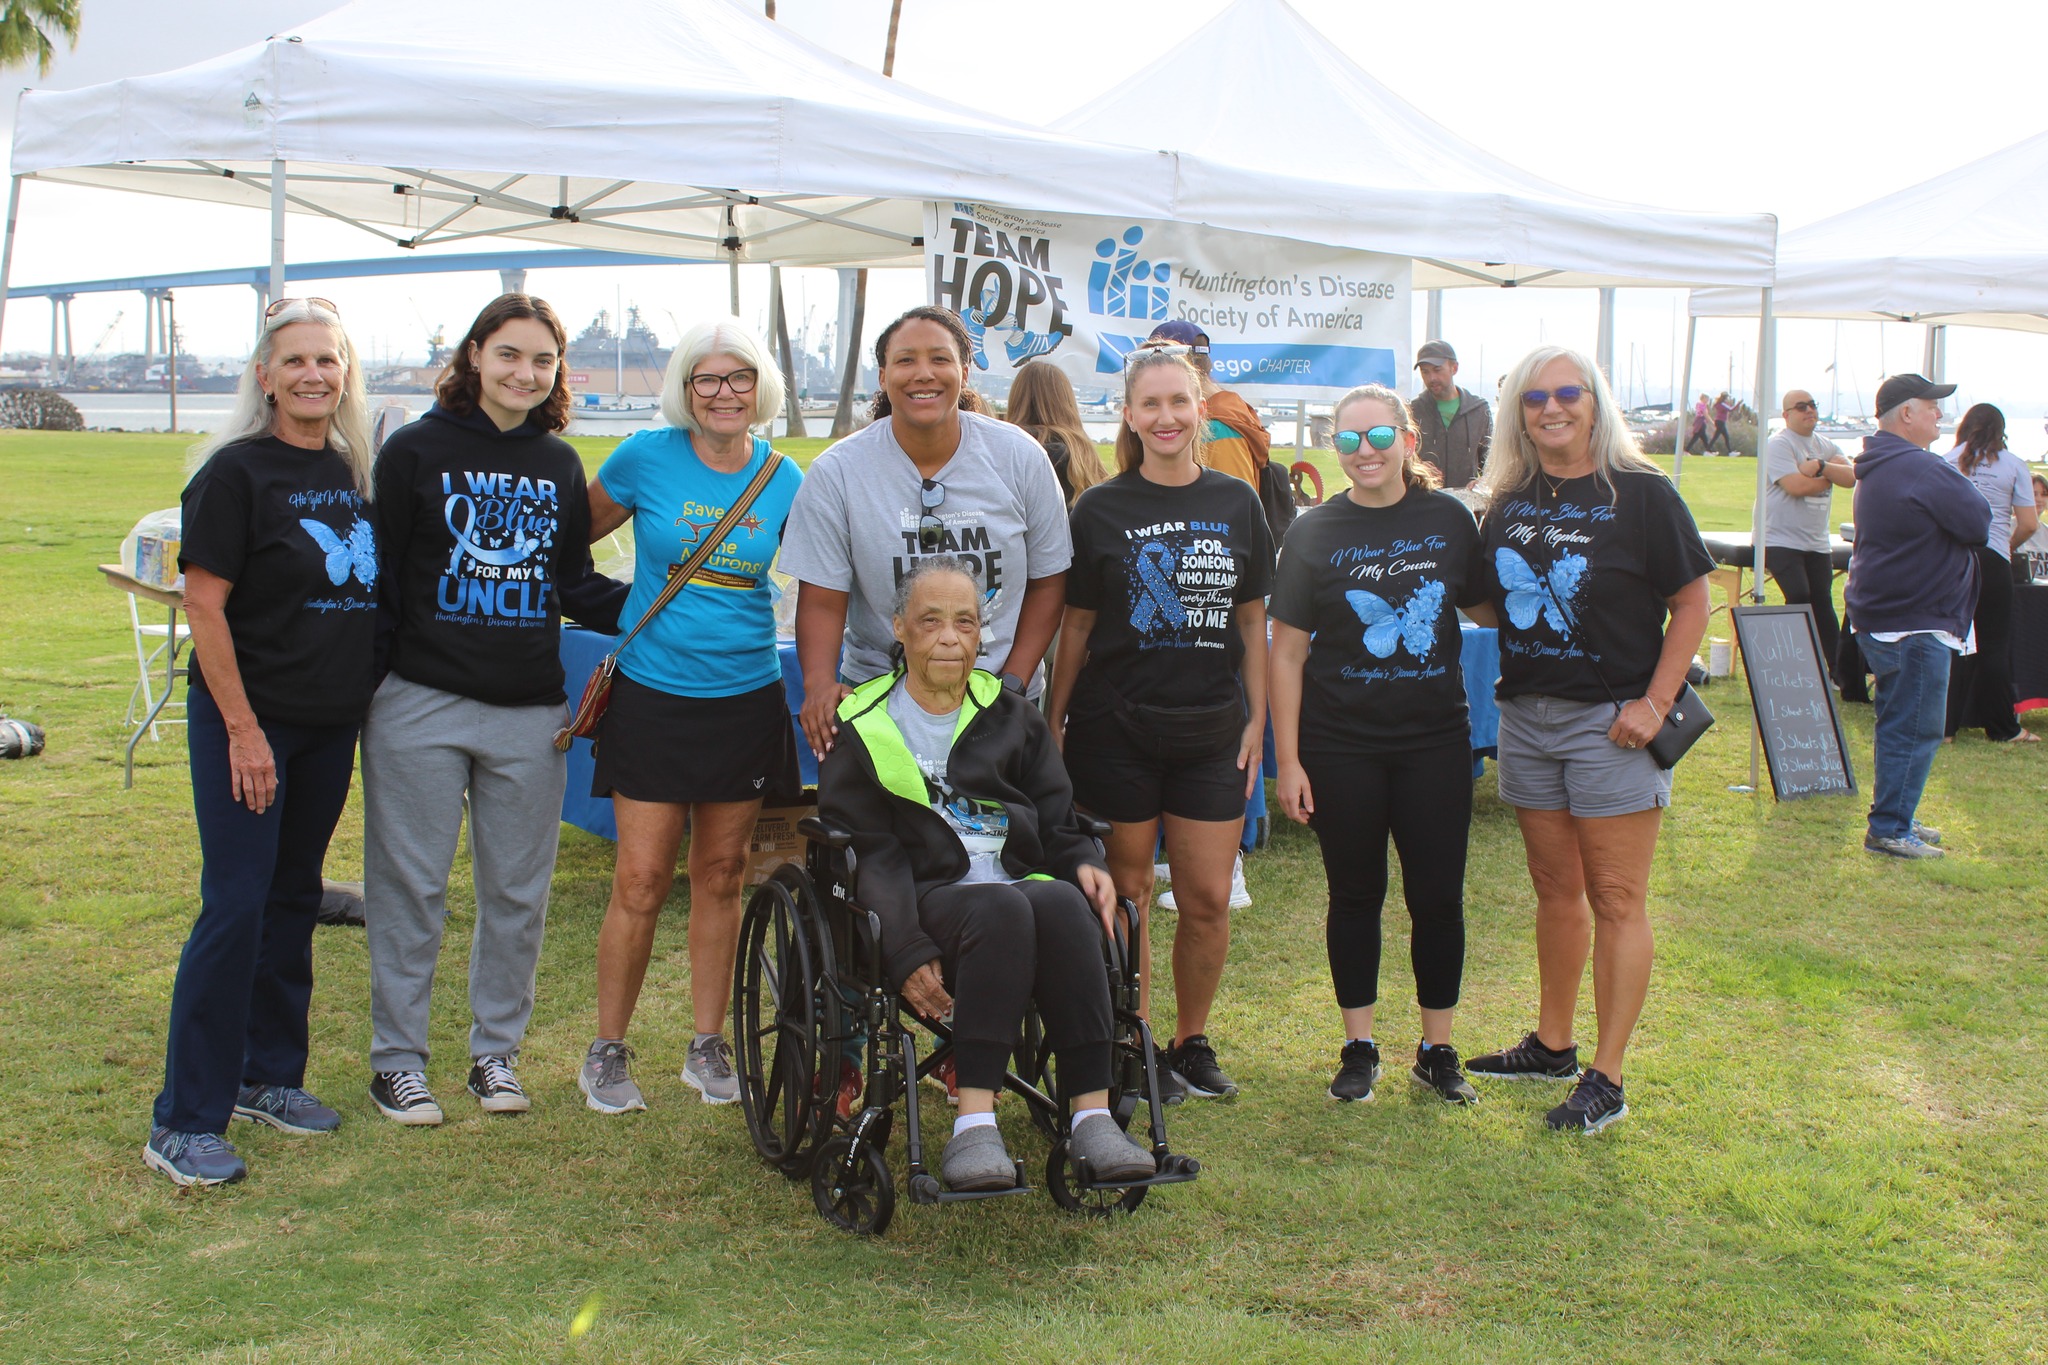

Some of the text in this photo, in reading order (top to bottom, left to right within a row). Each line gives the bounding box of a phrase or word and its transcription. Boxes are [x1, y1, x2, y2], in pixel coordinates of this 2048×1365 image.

[976, 211, 1046, 235] Society of America
[978, 204, 1031, 225] Hunngton's
[950, 217, 1050, 272] TEAM
[1179, 267, 1395, 301] Huntington's Disease
[934, 253, 1073, 337] HOPE
[1176, 299, 1363, 334] Society of America
[1211, 358, 1311, 377] ego CHAPTER
[441, 471, 558, 503] I WEAR
[476, 498, 550, 533] Blue
[682, 501, 725, 520] Save
[1549, 503, 1587, 521] Blue
[1590, 505, 1617, 524] For
[952, 518, 978, 526] America
[1125, 521, 1230, 540] I WEAR BLUE
[901, 527, 991, 555] TEAM
[1505, 522, 1595, 549] My Nephew
[1193, 539, 1223, 555] FOR
[1344, 544, 1384, 562] Wear
[1387, 539, 1423, 558] Blue
[1424, 534, 1447, 552] For
[681, 547, 765, 575] Nurons!
[1181, 555, 1235, 572] SOMEONE
[1349, 558, 1438, 582] My Cousin
[475, 565, 532, 580] FOR MY
[1175, 571, 1238, 588] WHO MEANS
[437, 575, 552, 619] UNCLE
[1180, 589, 1233, 609] everything
[434, 611, 484, 625] Huntington's
[487, 617, 517, 628] Disease
[1186, 610, 1228, 629] TO ME
[1194, 636, 1225, 650] Awareness
[1747, 620, 1806, 664] Raffle
[1776, 727, 1786, 751] 3
[1787, 734, 1819, 749] Sheets
[1790, 757, 1819, 772] Sheets
[773, 831, 796, 841] FRESH
[760, 842, 776, 853] YOU
